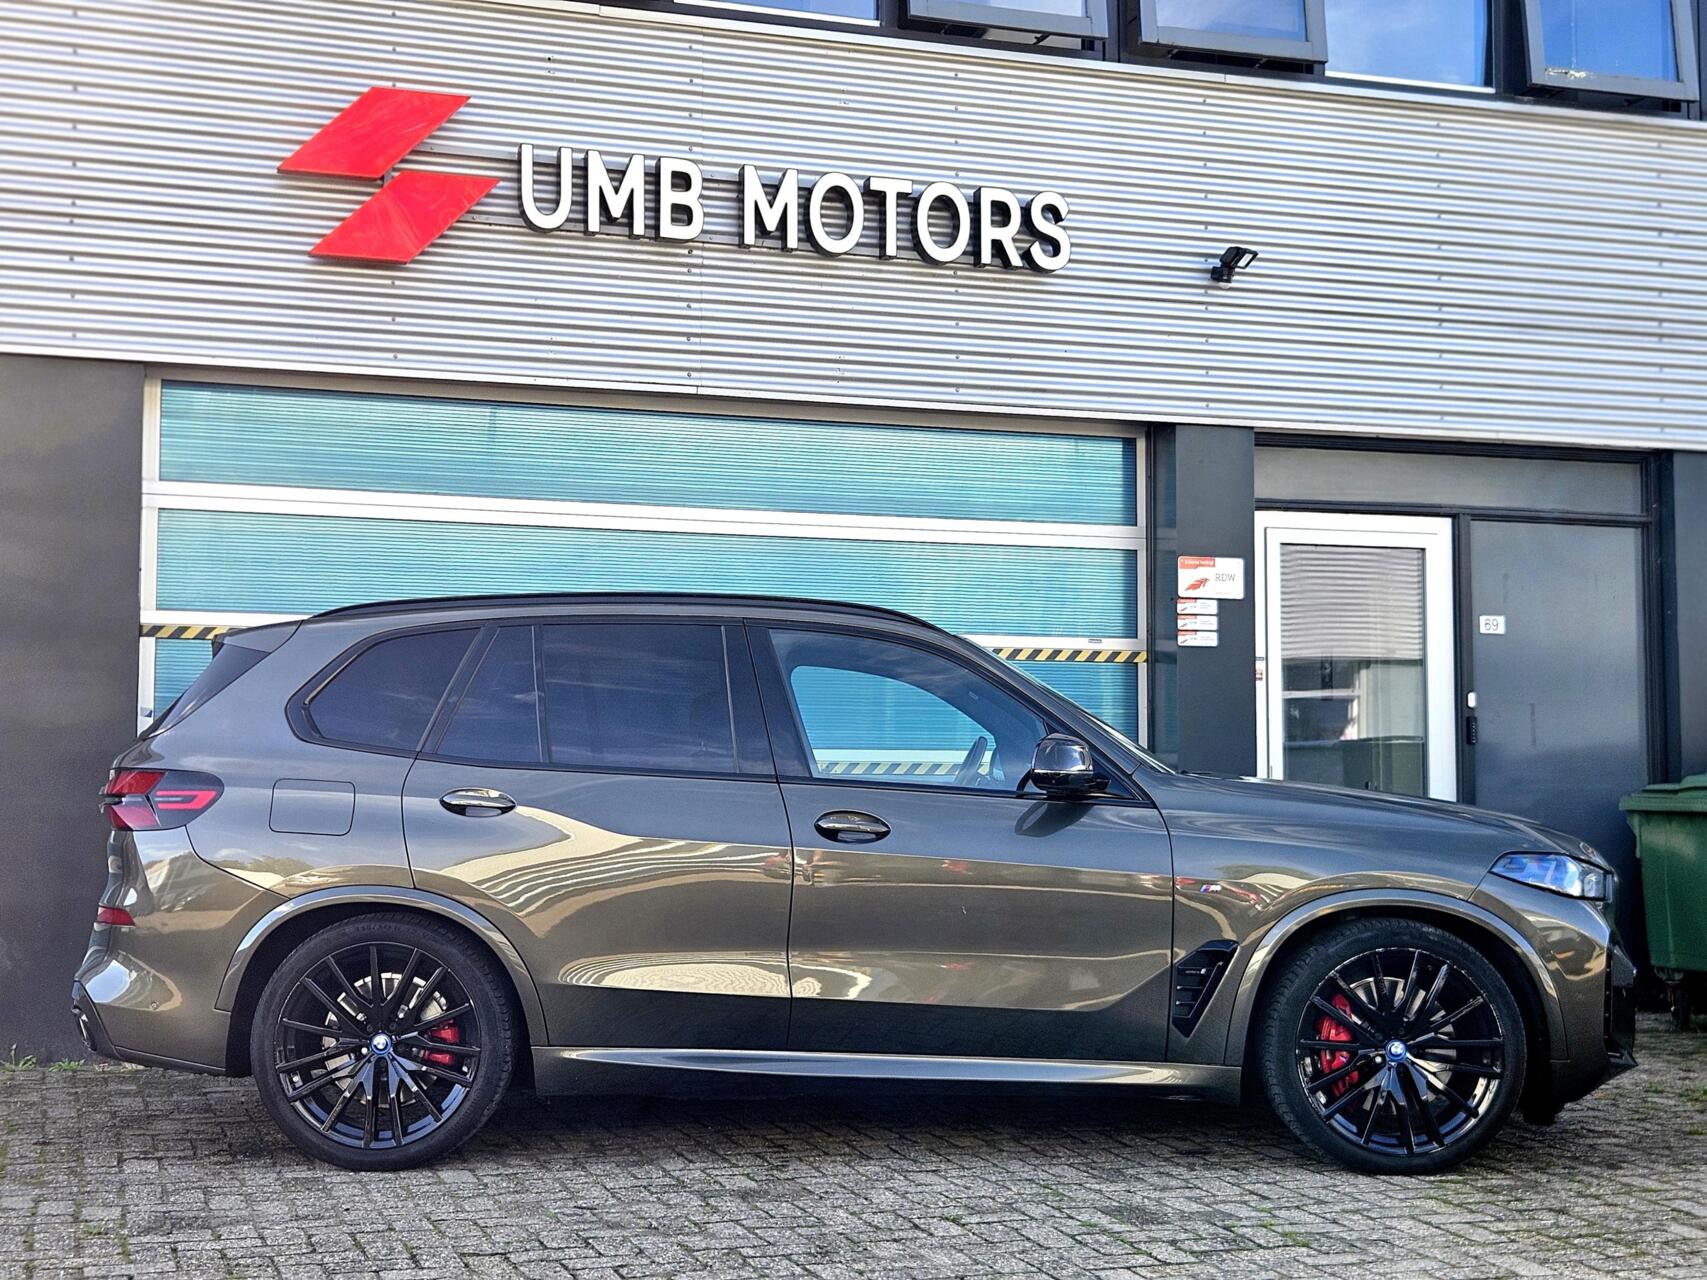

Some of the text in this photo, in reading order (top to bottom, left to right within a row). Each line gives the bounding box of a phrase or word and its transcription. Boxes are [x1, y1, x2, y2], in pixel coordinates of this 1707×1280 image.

[519, 143, 1072, 272] UMB MOTORS
[1215, 573, 1236, 582] RDW
[1484, 618, 1499, 631] 69
